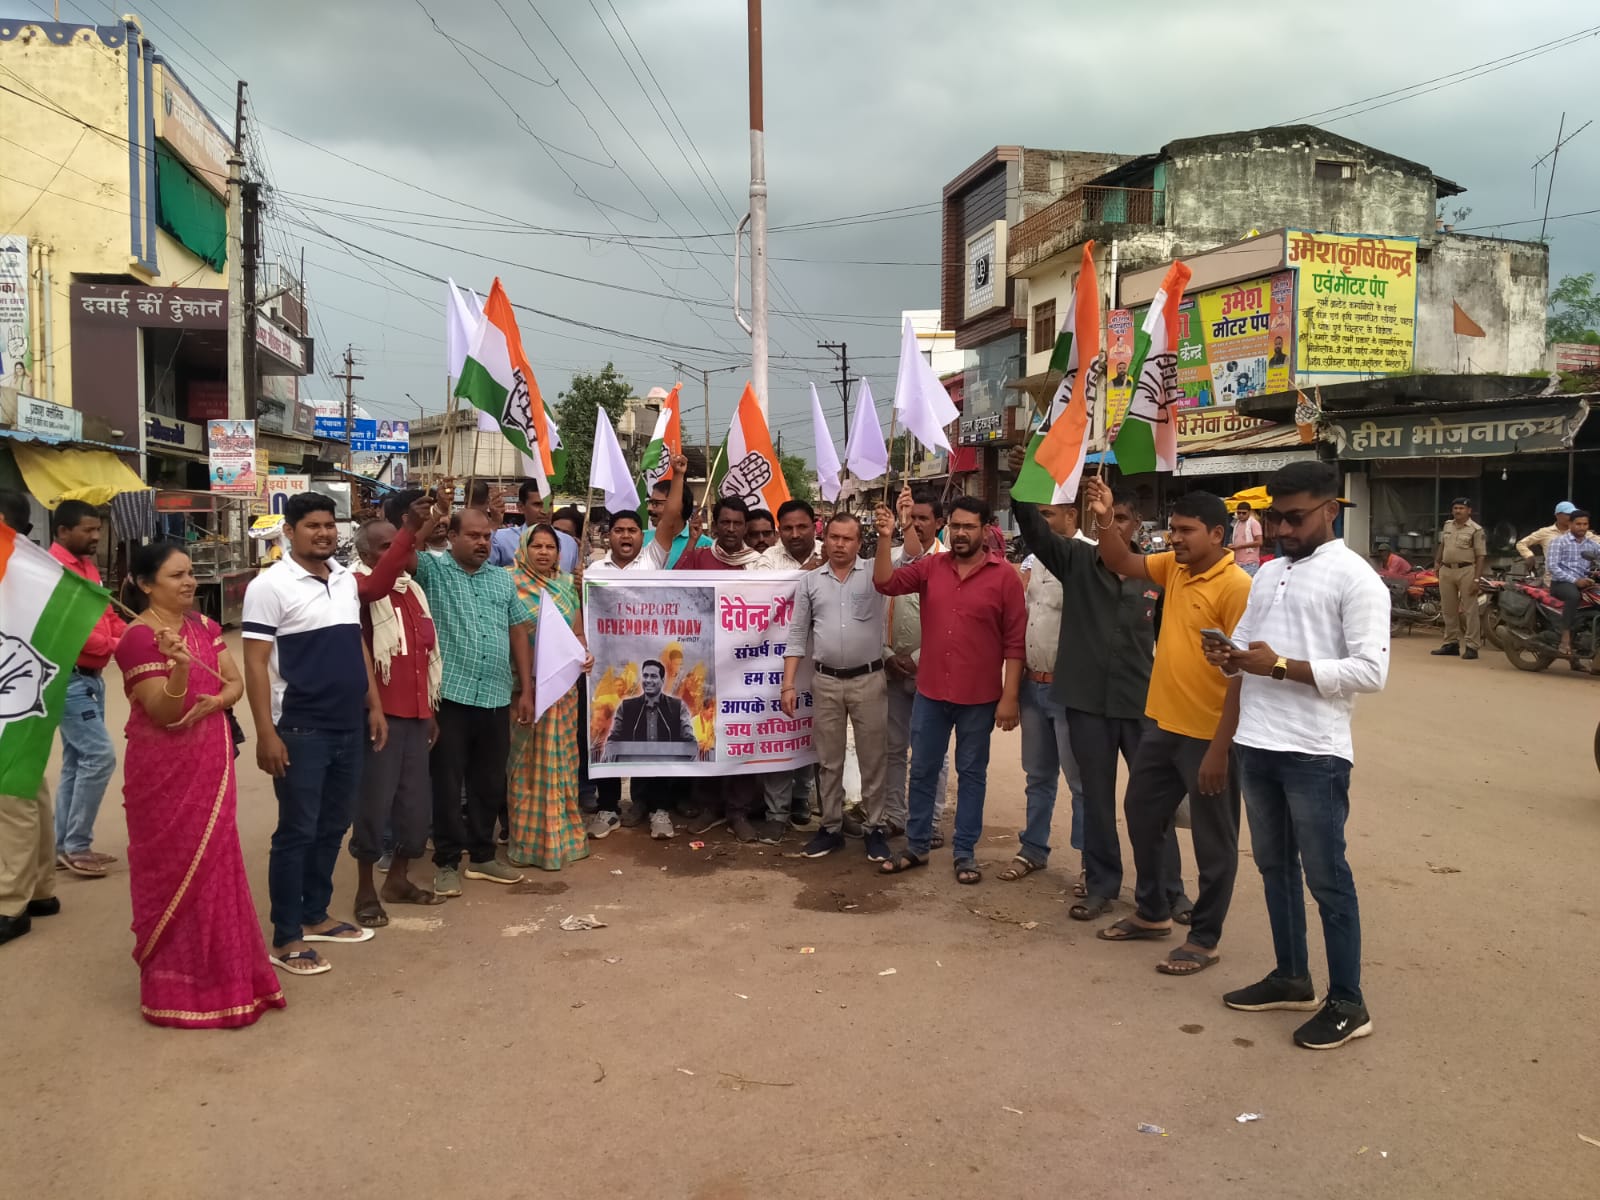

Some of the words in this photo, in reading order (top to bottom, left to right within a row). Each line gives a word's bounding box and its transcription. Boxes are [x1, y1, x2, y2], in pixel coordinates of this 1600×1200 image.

[1289, 232, 1338, 264] उमेश
[1338, 238, 1377, 274] कृषि
[1377, 239, 1413, 277] केन्द्र
[1312, 269, 1333, 294] एवं
[1333, 270, 1368, 296] मोटर
[1369, 275, 1389, 299] पंप
[81, 290, 130, 317] दवाई
[137, 293, 164, 315] की
[169, 296, 223, 323] दुकान
[1221, 285, 1262, 315] उमेश
[1212, 316, 1248, 338] मोटर
[1250, 310, 1270, 331] पंप
[1179, 342, 1203, 361] केन्द्र
[1190, 412, 1222, 435] सेवा
[1351, 421, 1404, 451] हीरा
[1412, 416, 1567, 446] भोजनालय
[269, 477, 287, 491] इयों
[290, 480, 304, 490] पर
[617, 602, 622, 615] I
[625, 602, 680, 615] SUPPORT
[721, 596, 771, 632] देवेन्द्र
[597, 618, 658, 636] DEVENDRA
[663, 618, 702, 636] YADAV
[734, 640, 770, 659] संघर्ष
[744, 672, 764, 685] हम
[721, 696, 765, 713] आपके
[725, 723, 752, 737] जय
[727, 743, 754, 756] जय
[759, 735, 811, 753] सतनाम
